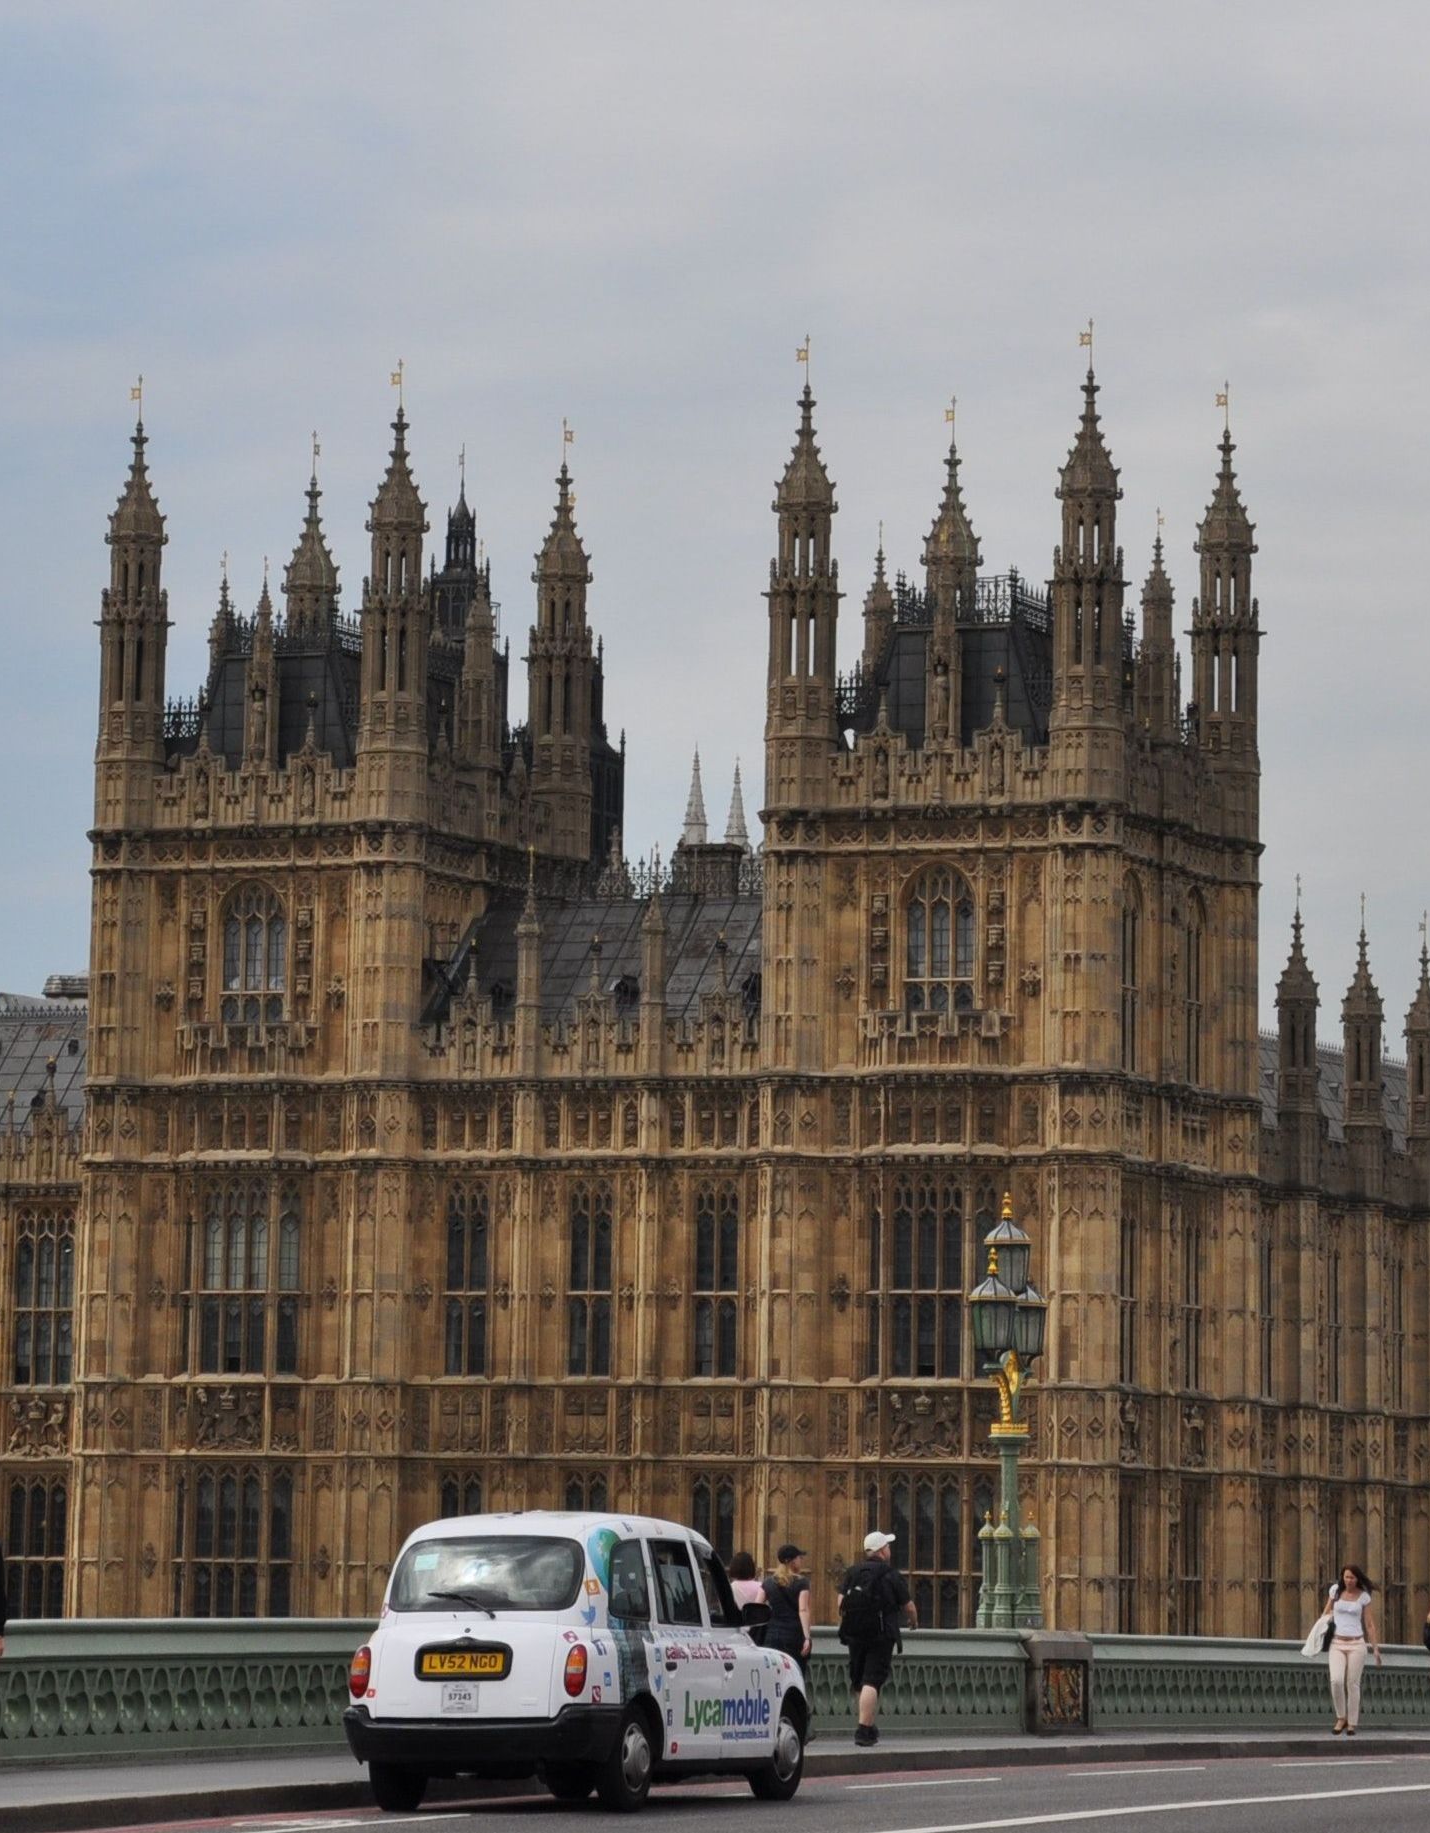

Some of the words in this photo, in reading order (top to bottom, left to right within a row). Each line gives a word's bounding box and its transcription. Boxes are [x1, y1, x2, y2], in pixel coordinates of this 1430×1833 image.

[428, 1655, 466, 1670] LV52
[469, 1654, 498, 1670] NGO
[684, 1688, 770, 1735] Lycamobile
